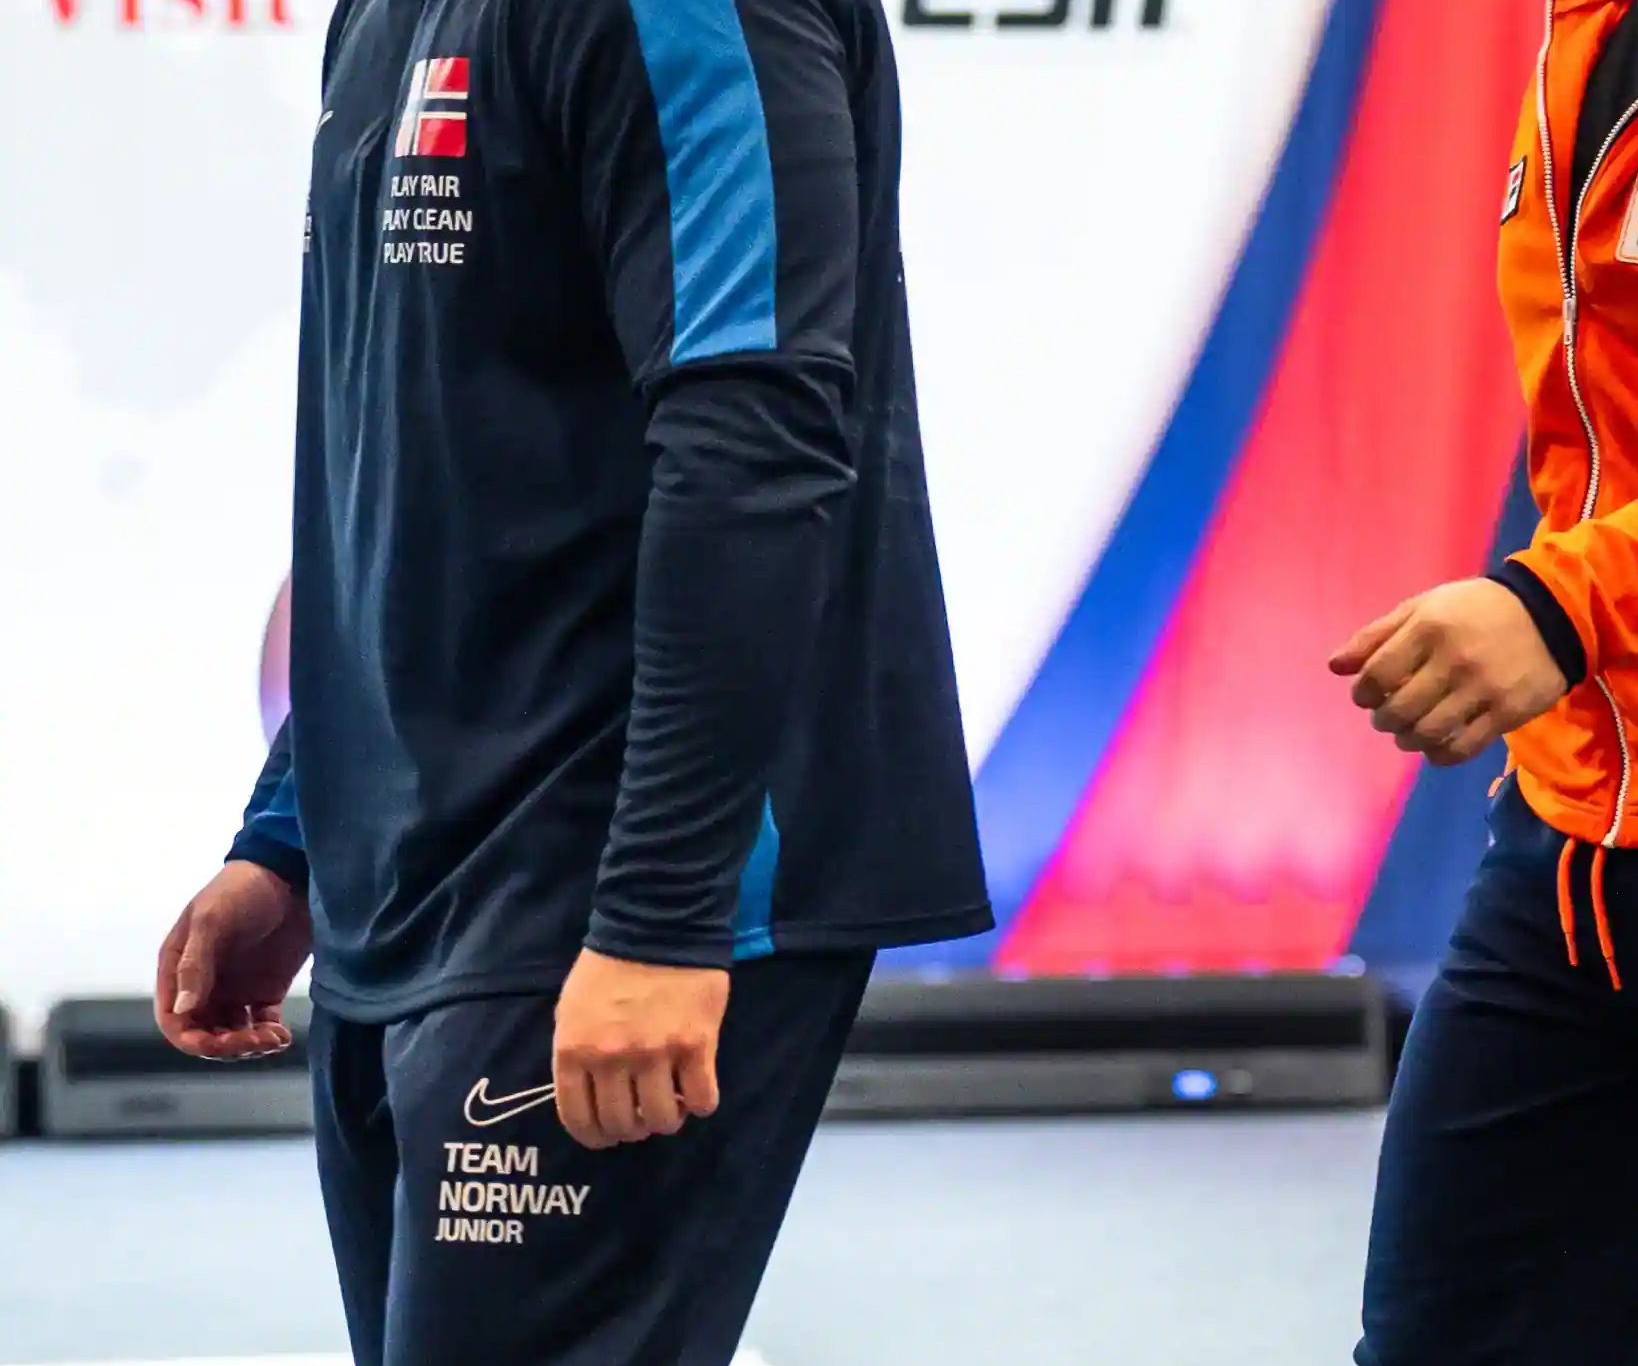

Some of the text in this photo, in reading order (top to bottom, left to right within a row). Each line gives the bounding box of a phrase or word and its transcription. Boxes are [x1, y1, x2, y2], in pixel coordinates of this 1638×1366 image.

[383, 241, 416, 264] PLAY
[443, 1141, 540, 1177] TEAM
[438, 1180, 590, 1216] NORWAY
[434, 1217, 525, 1244] JUNIOR
